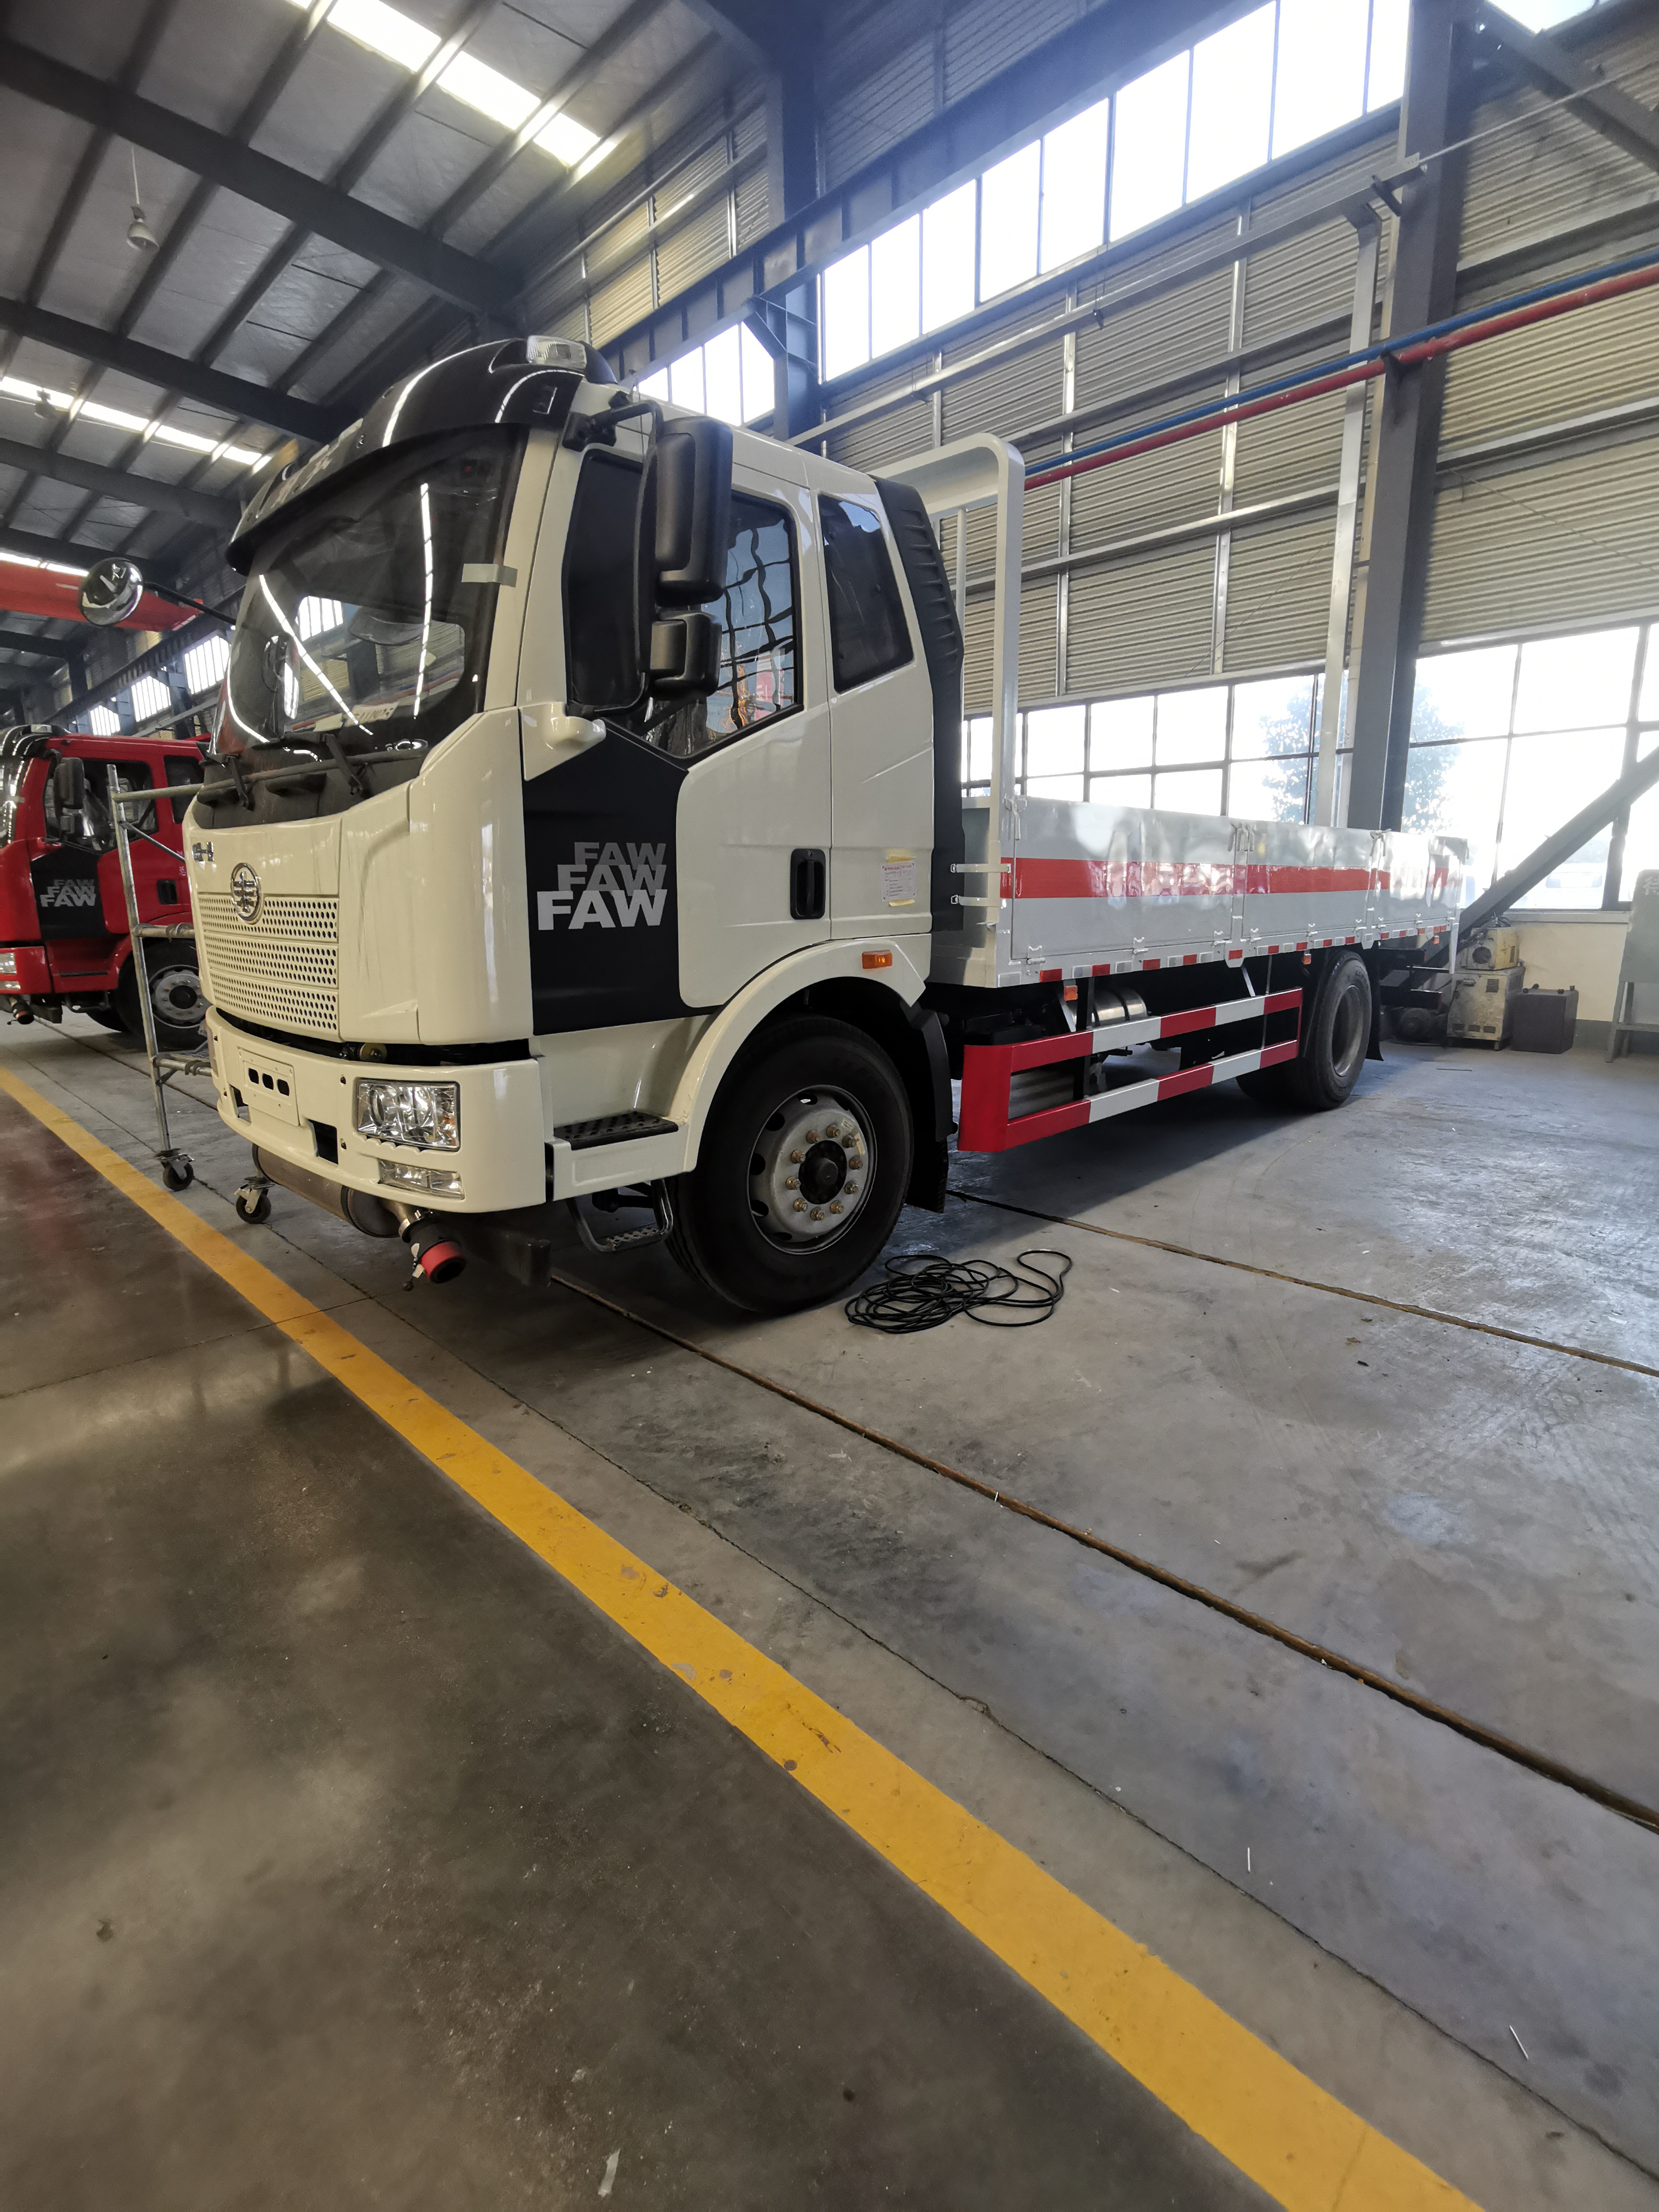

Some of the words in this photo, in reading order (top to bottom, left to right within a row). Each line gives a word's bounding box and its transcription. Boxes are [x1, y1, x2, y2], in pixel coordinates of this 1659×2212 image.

[574, 842, 666, 870] FAW
[557, 864, 666, 896] FAW
[40, 893, 96, 907] FAW
[537, 889, 667, 930] FAW
